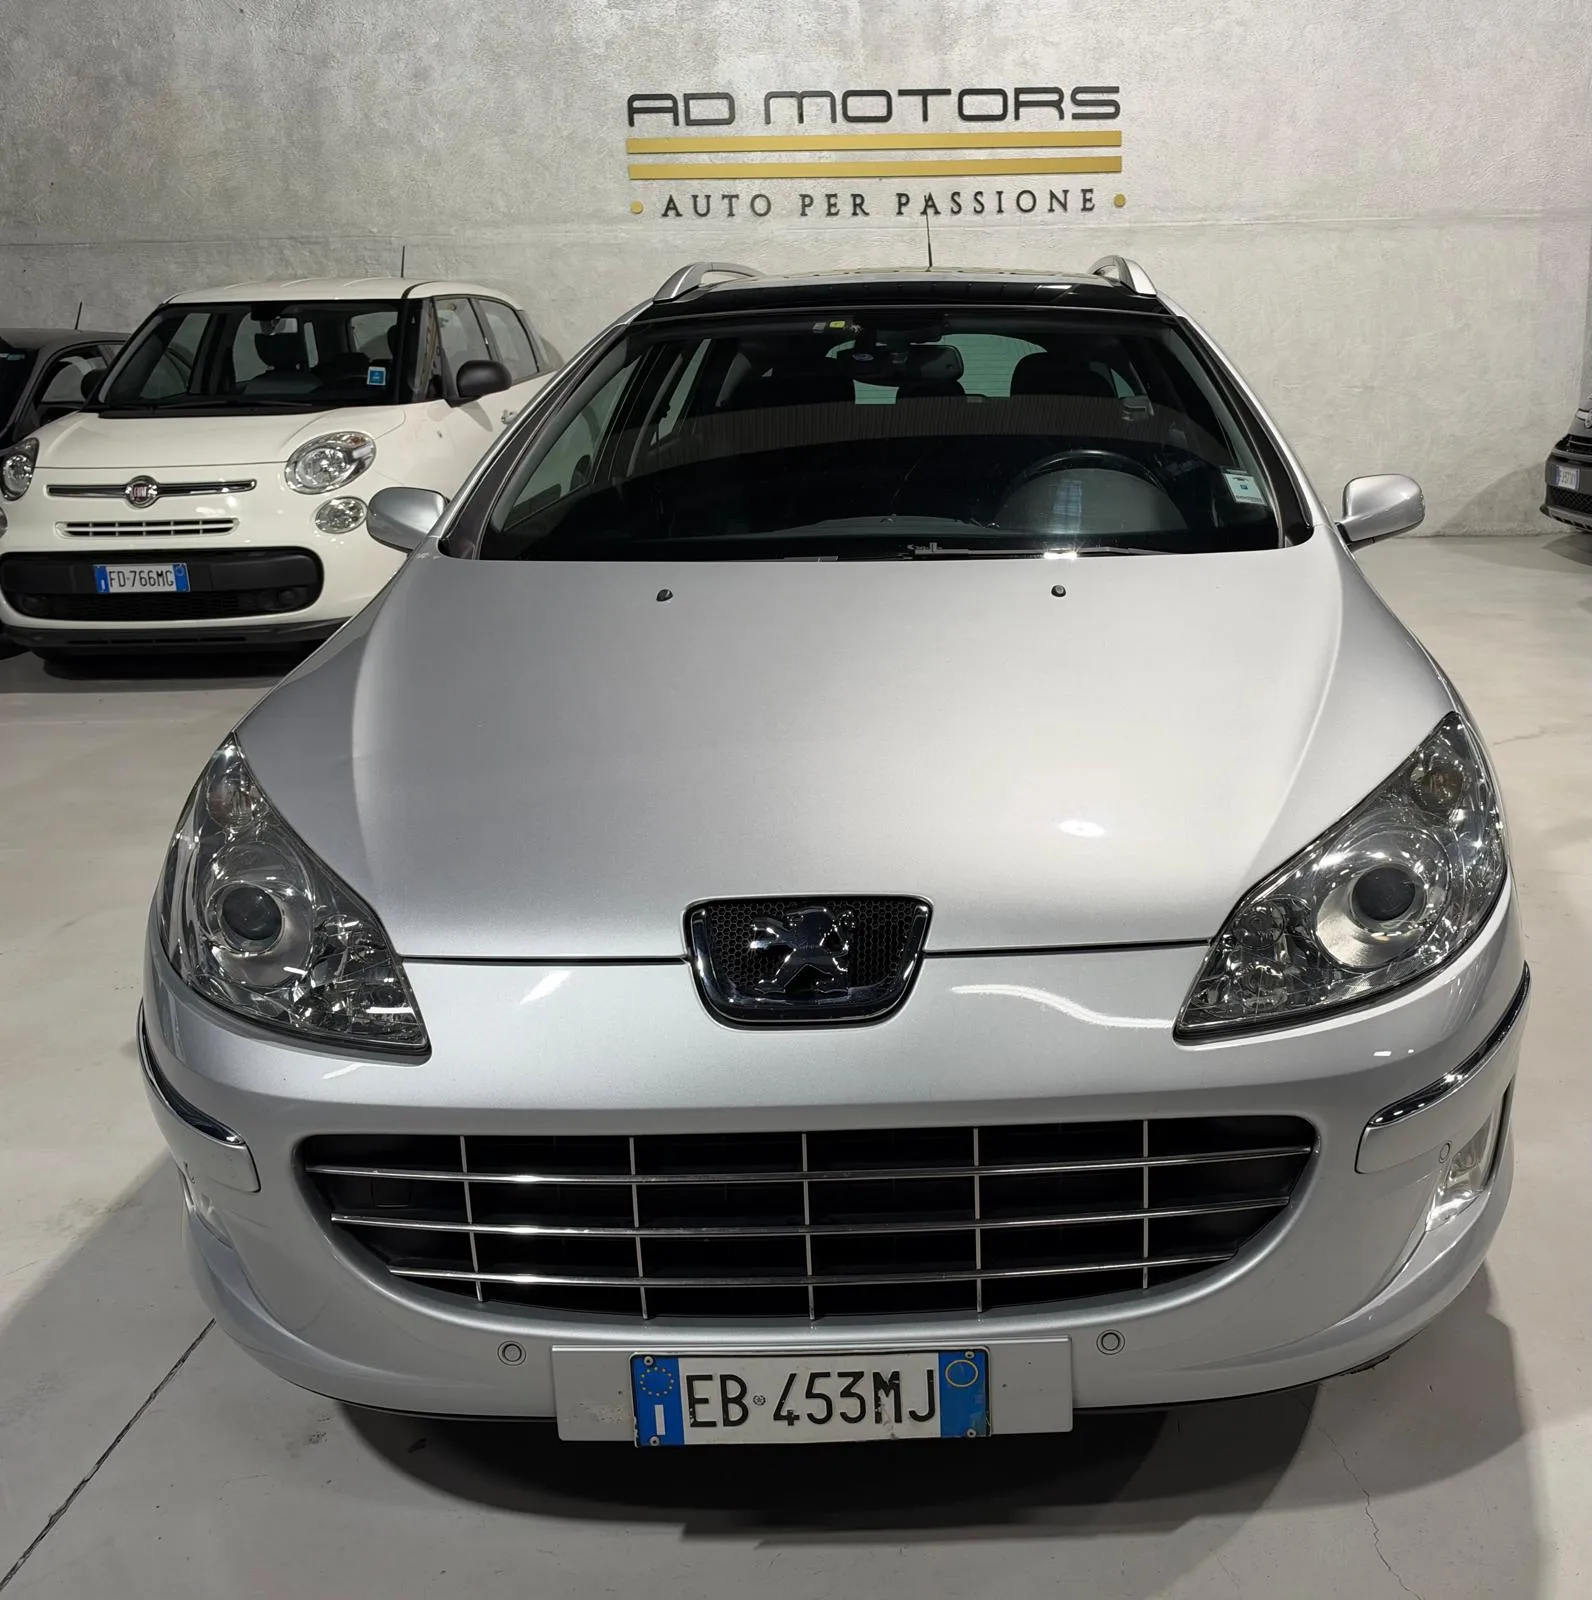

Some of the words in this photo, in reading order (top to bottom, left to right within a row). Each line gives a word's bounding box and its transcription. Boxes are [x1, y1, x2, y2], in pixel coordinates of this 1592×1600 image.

[627, 92, 735, 127] AD
[764, 86, 1121, 124] MOTORS
[661, 193, 772, 217] AUTO
[799, 192, 870, 217] PER
[896, 188, 1096, 216] PASSIONE
[686, 1373, 749, 1428] EB
[773, 1369, 936, 1427] 453MJ
